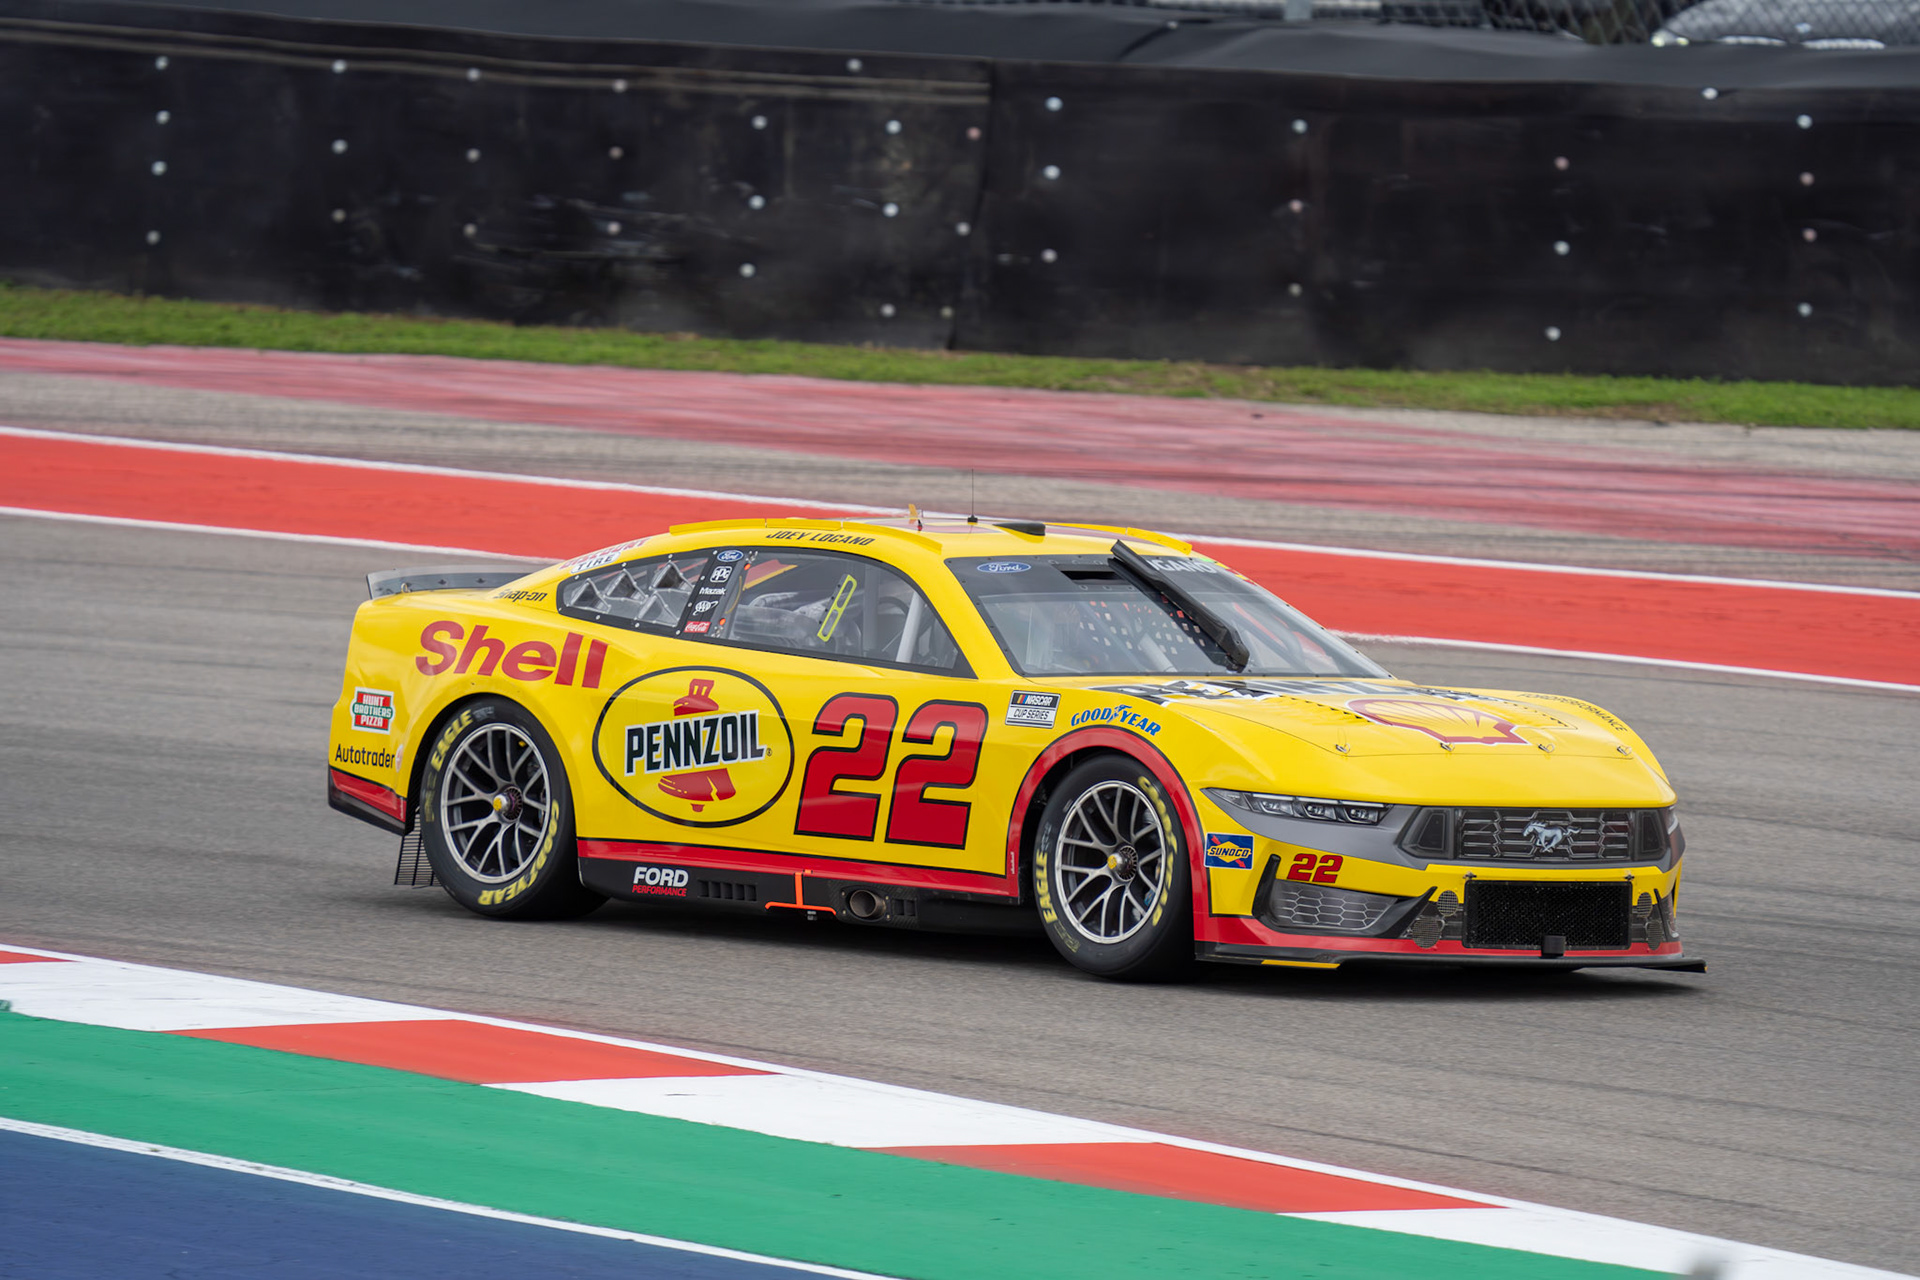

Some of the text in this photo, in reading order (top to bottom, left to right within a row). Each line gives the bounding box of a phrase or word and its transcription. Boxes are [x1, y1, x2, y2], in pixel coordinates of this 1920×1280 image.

[766, 530, 876, 546] JOEY LOGANO
[577, 553, 615, 571] TIRE
[989, 562, 1022, 573] Ford
[699, 587, 726, 595] Mazak
[415, 620, 609, 689] Shell
[362, 694, 384, 706] HUNT
[1025, 694, 1053, 706] NASCAR
[353, 703, 392, 718] BROTHERS
[1013, 708, 1050, 720] CUP SERIES
[360, 715, 383, 727] PIZZA
[430, 709, 474, 772] EAGLE
[625, 711, 766, 776] PENNZOIL
[335, 744, 395, 768] Autotrader
[793, 691, 989, 850] 22
[1209, 847, 1250, 857] SUNOCO
[1287, 853, 1343, 883] 22
[633, 866, 689, 887] FORD
[631, 884, 688, 897] PERFORMANCE
[1036, 849, 1058, 923] EAGLE
